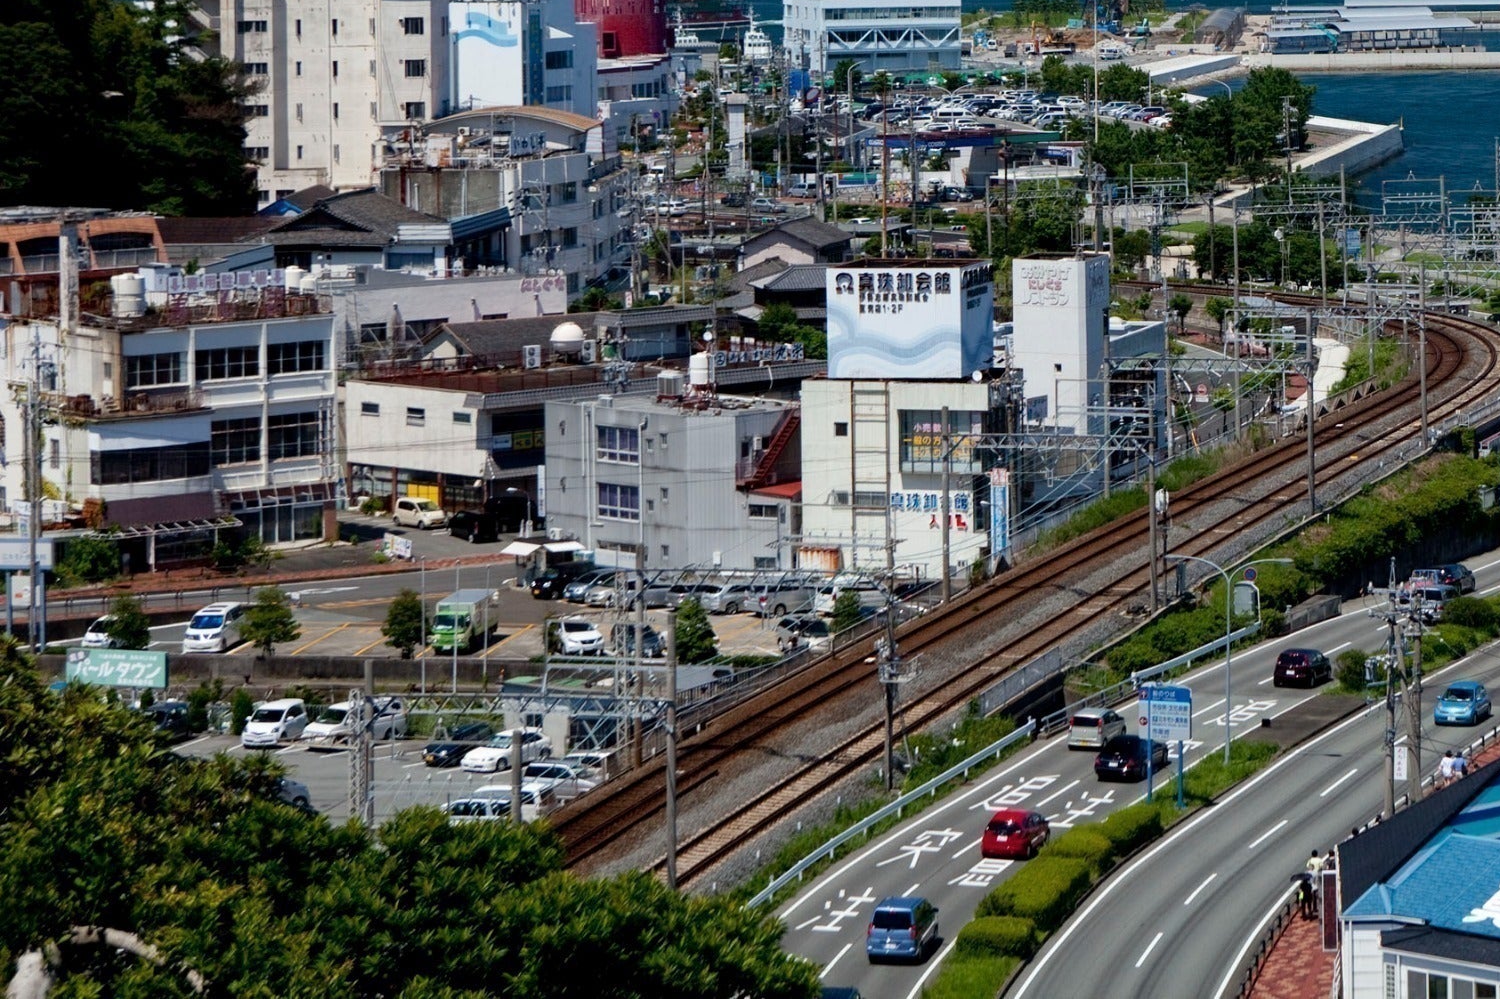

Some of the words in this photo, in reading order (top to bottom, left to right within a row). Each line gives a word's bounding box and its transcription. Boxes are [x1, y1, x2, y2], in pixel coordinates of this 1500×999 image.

[858, 272, 951, 294] 真珠卸会館
[891, 493, 970, 511] 真珠卸館
[73, 658, 162, 680] パールタウン
